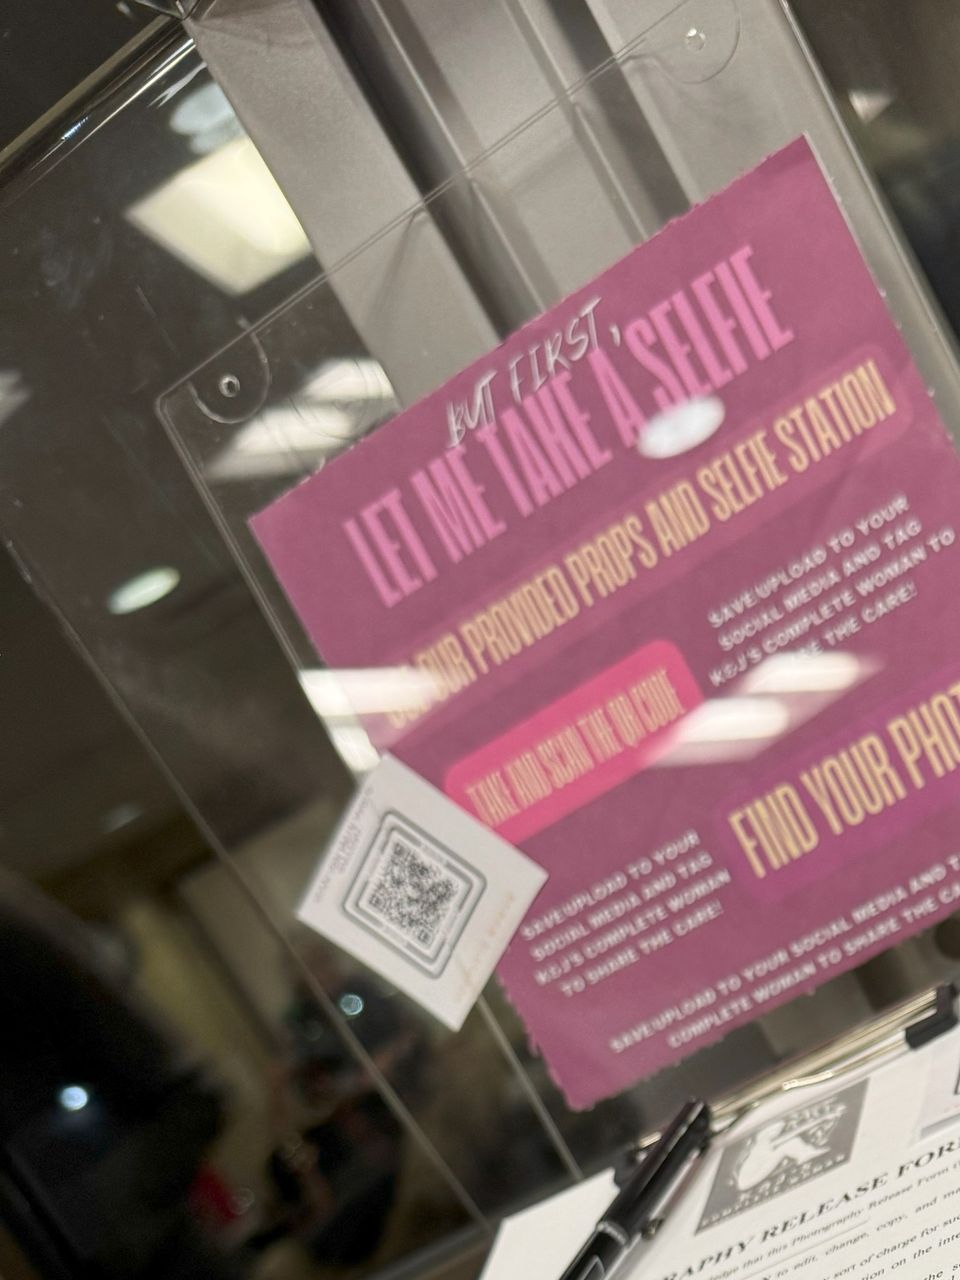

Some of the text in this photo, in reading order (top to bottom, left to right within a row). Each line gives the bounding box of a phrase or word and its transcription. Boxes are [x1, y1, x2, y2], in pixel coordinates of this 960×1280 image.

[340, 241, 796, 609] LET ME TAKE A SELFIE
[444, 294, 624, 450] BUT FIRST,
[457, 562, 583, 675] PROVIDED
[561, 510, 662, 609] PROPS
[640, 475, 714, 558] AND
[693, 426, 790, 524] SELFIE
[769, 355, 899, 476] STATION
[825, 525, 858, 556] TO
[854, 491, 912, 538] YOUR
[716, 514, 924, 653] SOCIAL MEDIA AND TAG
[759, 586, 858, 656] COMPLETE
[853, 542, 929, 599] WOMAN
[925, 524, 959, 556] TO
[821, 613, 862, 648] THE
[464, 666, 688, 832] TAKE AND SCAN THE QR CODE
[624, 853, 655, 882] TO
[648, 826, 702, 869] YOUR
[725, 777, 823, 880] FIND
[797, 728, 910, 840] YOUR
[528, 847, 715, 964] SOCIAL MEDIA AND TAG
[580, 901, 669, 961] COMPLETE
[664, 865, 733, 914] WOMAN
[714, 971, 745, 998] TO
[739, 945, 792, 985] YOUR
[787, 912, 853, 959] SOCIAL
[848, 882, 910, 926] MEDIA
[904, 859, 950, 895] AND
[558, 973, 589, 1000] TO
[581, 944, 641, 987] SHARE
[636, 925, 675, 957] THE
[664, 992, 755, 1051] COMPLETE
[749, 958, 818, 1006] WOMAN
[814, 943, 845, 971] TO
[840, 913, 902, 957] SHARE
[898, 892, 939, 926] THE
[760, 1170, 890, 1243] RELEASE
[914, 1194, 938, 1214] and
[916, 1163, 949, 1187] Form
[832, 1260, 857, 1279] sort
[858, 1252, 874, 1267] of
[875, 1232, 917, 1262] charge
[920, 1222, 938, 1238] for
[890, 1256, 907, 1270] on
[912, 1241, 933, 1260] the
